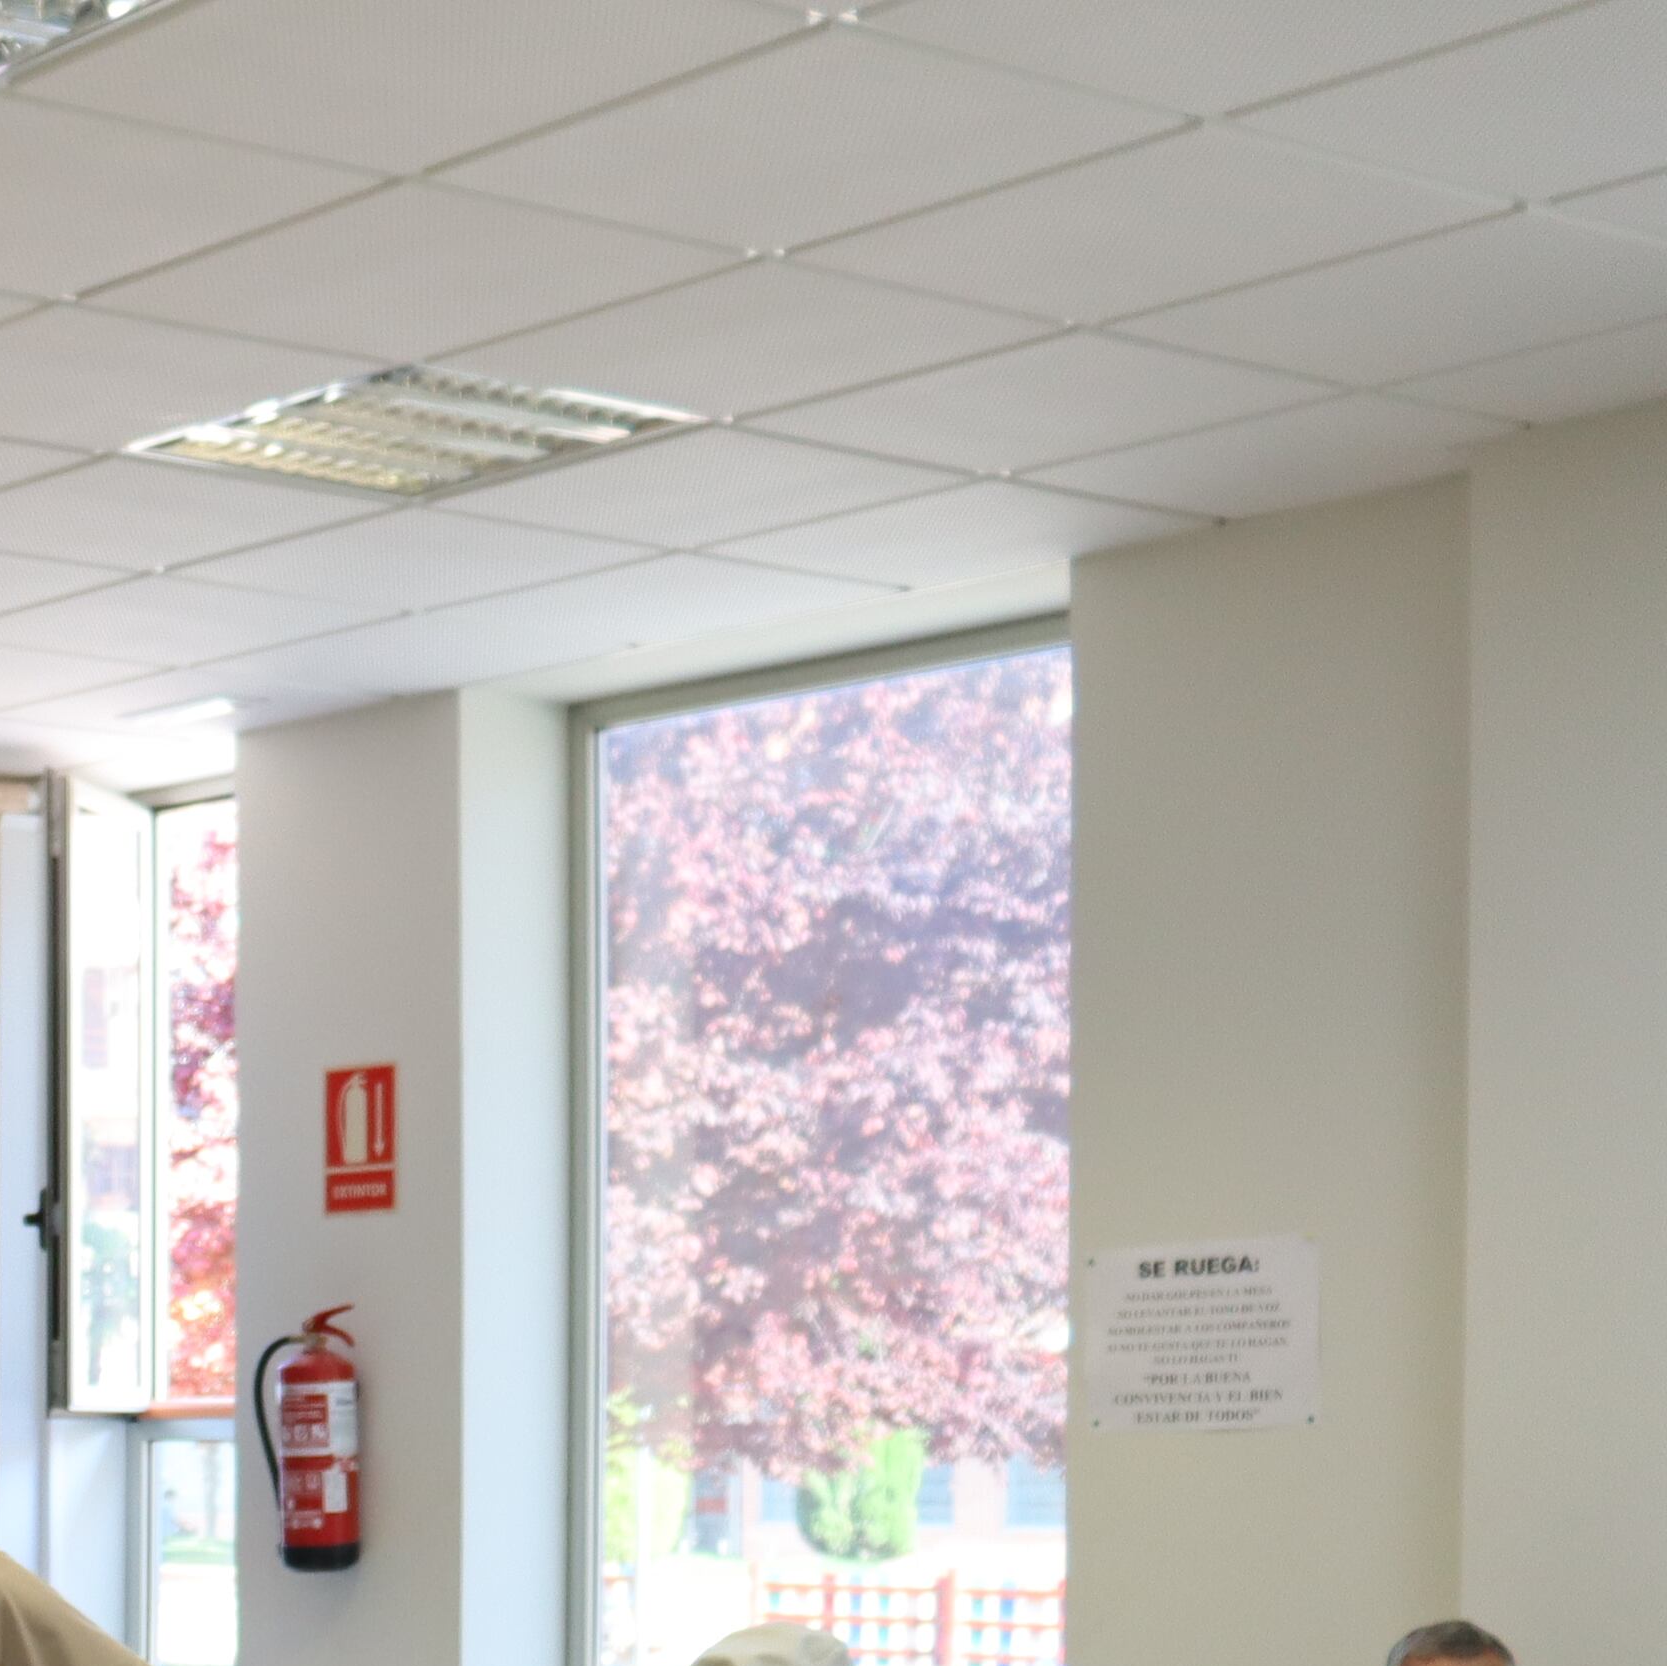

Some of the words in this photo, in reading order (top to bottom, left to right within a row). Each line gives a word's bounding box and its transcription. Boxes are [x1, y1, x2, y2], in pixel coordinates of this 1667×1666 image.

[1138, 1261, 1166, 1278] SE
[1174, 1255, 1260, 1276] RUEGA:
[1243, 1287, 1273, 1296] MESA
[1210, 1305, 1239, 1315] TONO
[1182, 1372, 1202, 1383] LA
[1204, 1371, 1252, 1383] BUENA
[1114, 1392, 1211, 1405] CONVIVENCIA
[1215, 1392, 1224, 1402] Y
[1228, 1391, 1242, 1402] EL
[1250, 1389, 1284, 1401] BIEN
[1136, 1411, 1180, 1424] ESTAR
[1185, 1411, 1200, 1423] DE
